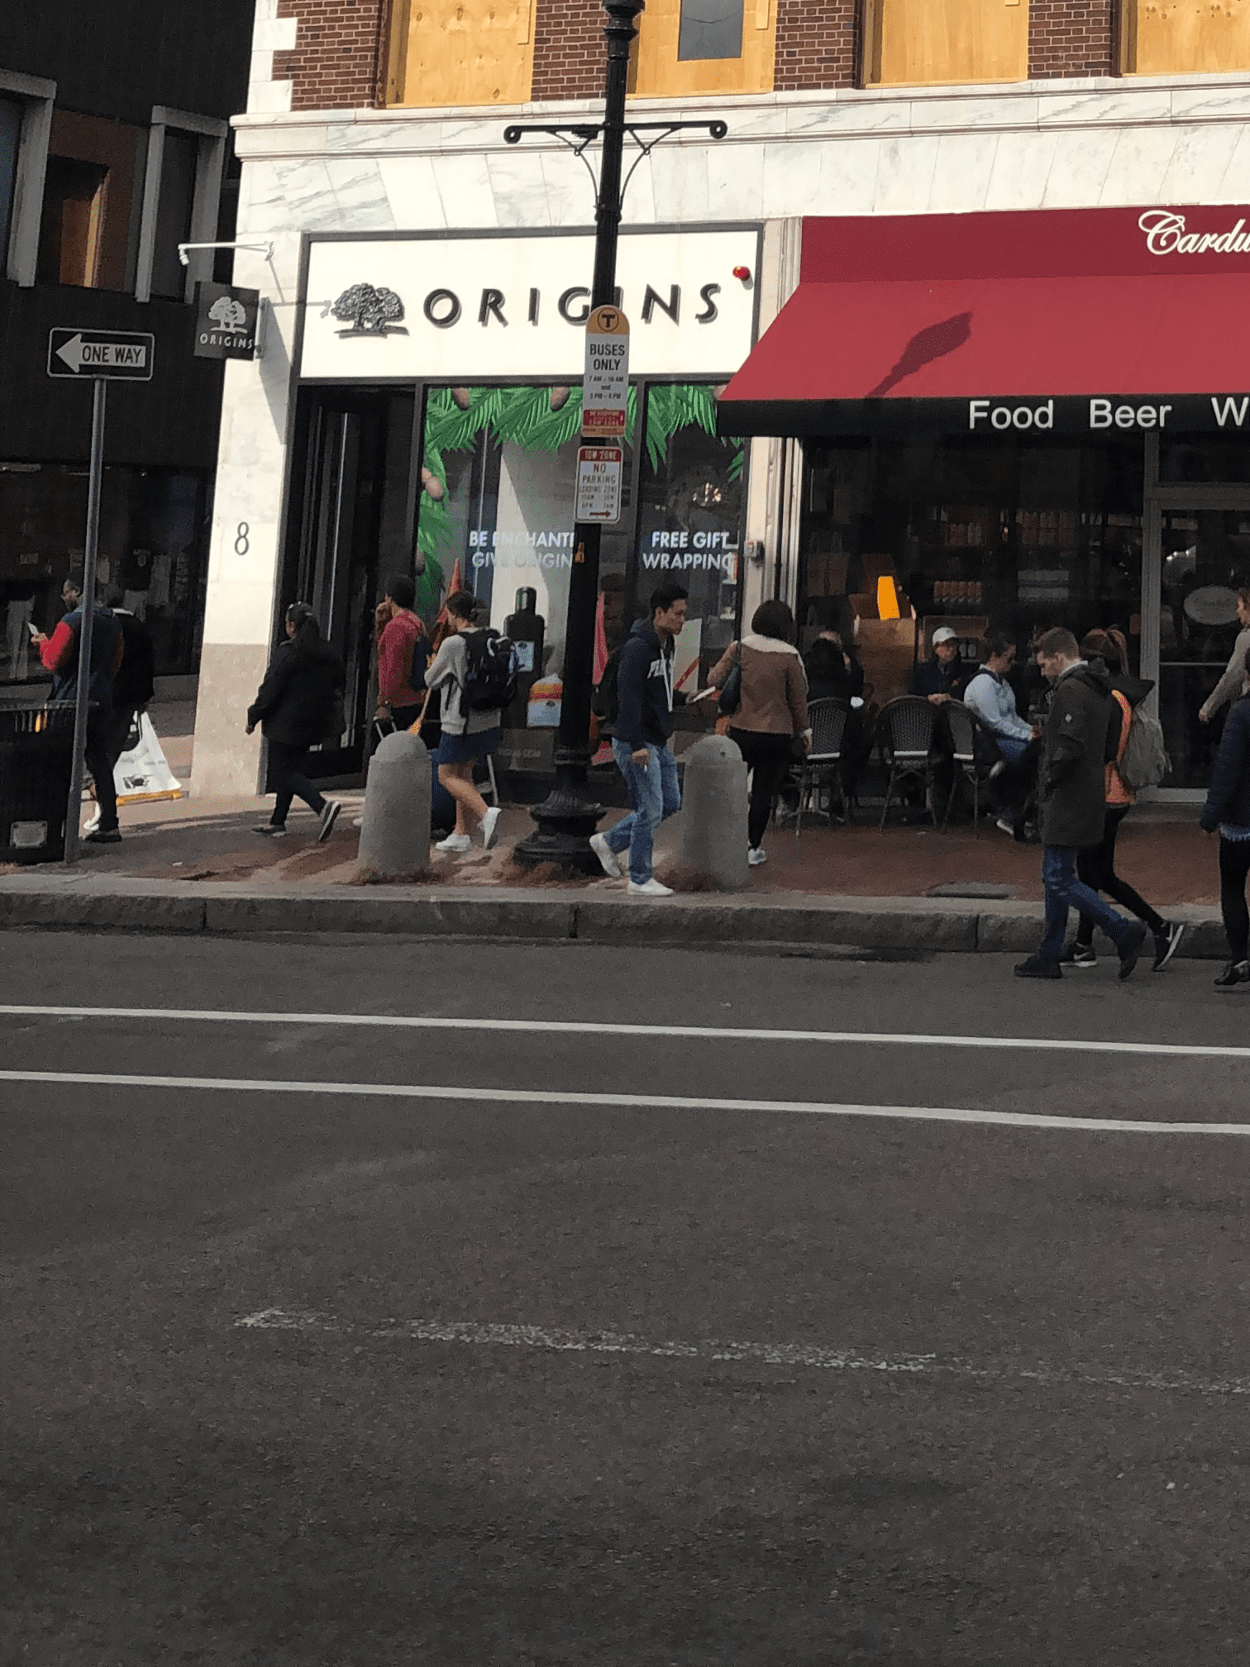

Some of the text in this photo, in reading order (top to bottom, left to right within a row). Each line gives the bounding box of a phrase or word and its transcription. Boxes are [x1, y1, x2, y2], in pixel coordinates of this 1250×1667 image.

[601, 314, 616, 328] T
[200, 333, 254, 350] ORIGINS
[589, 343, 626, 356] BUSES
[82, 344, 143, 364] ONE WAY
[593, 358, 621, 371] ONLY
[969, 399, 1054, 429] Food
[1089, 399, 1172, 428] Beer
[593, 463, 606, 474] NO
[582, 475, 616, 484] PARKING
[234, 521, 249, 556] 8
[469, 531, 488, 547] BE
[651, 531, 730, 549] FREE GIFT
[514, 552, 574, 569] ORIGIN
[643, 551, 732, 570] WRAPPING
